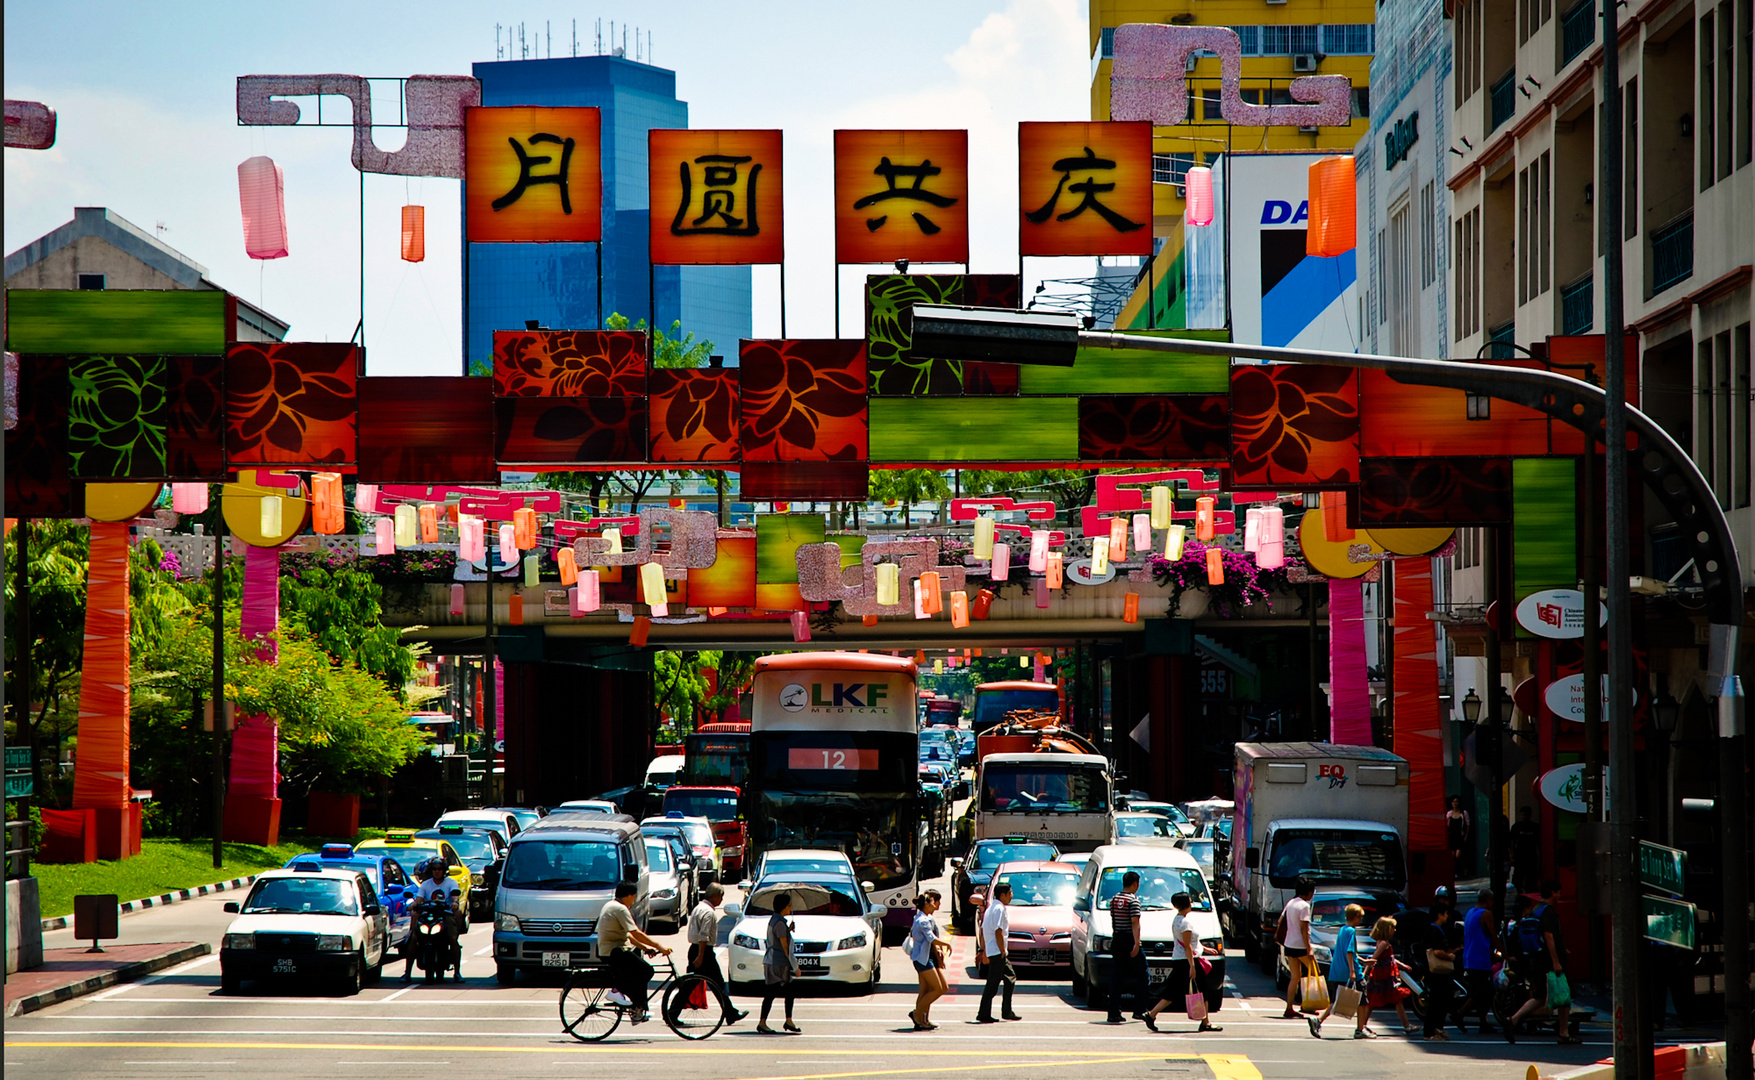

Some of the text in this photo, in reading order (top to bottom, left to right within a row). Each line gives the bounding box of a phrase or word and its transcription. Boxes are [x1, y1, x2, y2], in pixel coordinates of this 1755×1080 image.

[811, 683, 888, 707] LKF
[822, 751, 846, 769] 12
[1319, 764, 1345, 779] EQ
[1329, 778, 1347, 789] Dry
[277, 958, 293, 966] SHB
